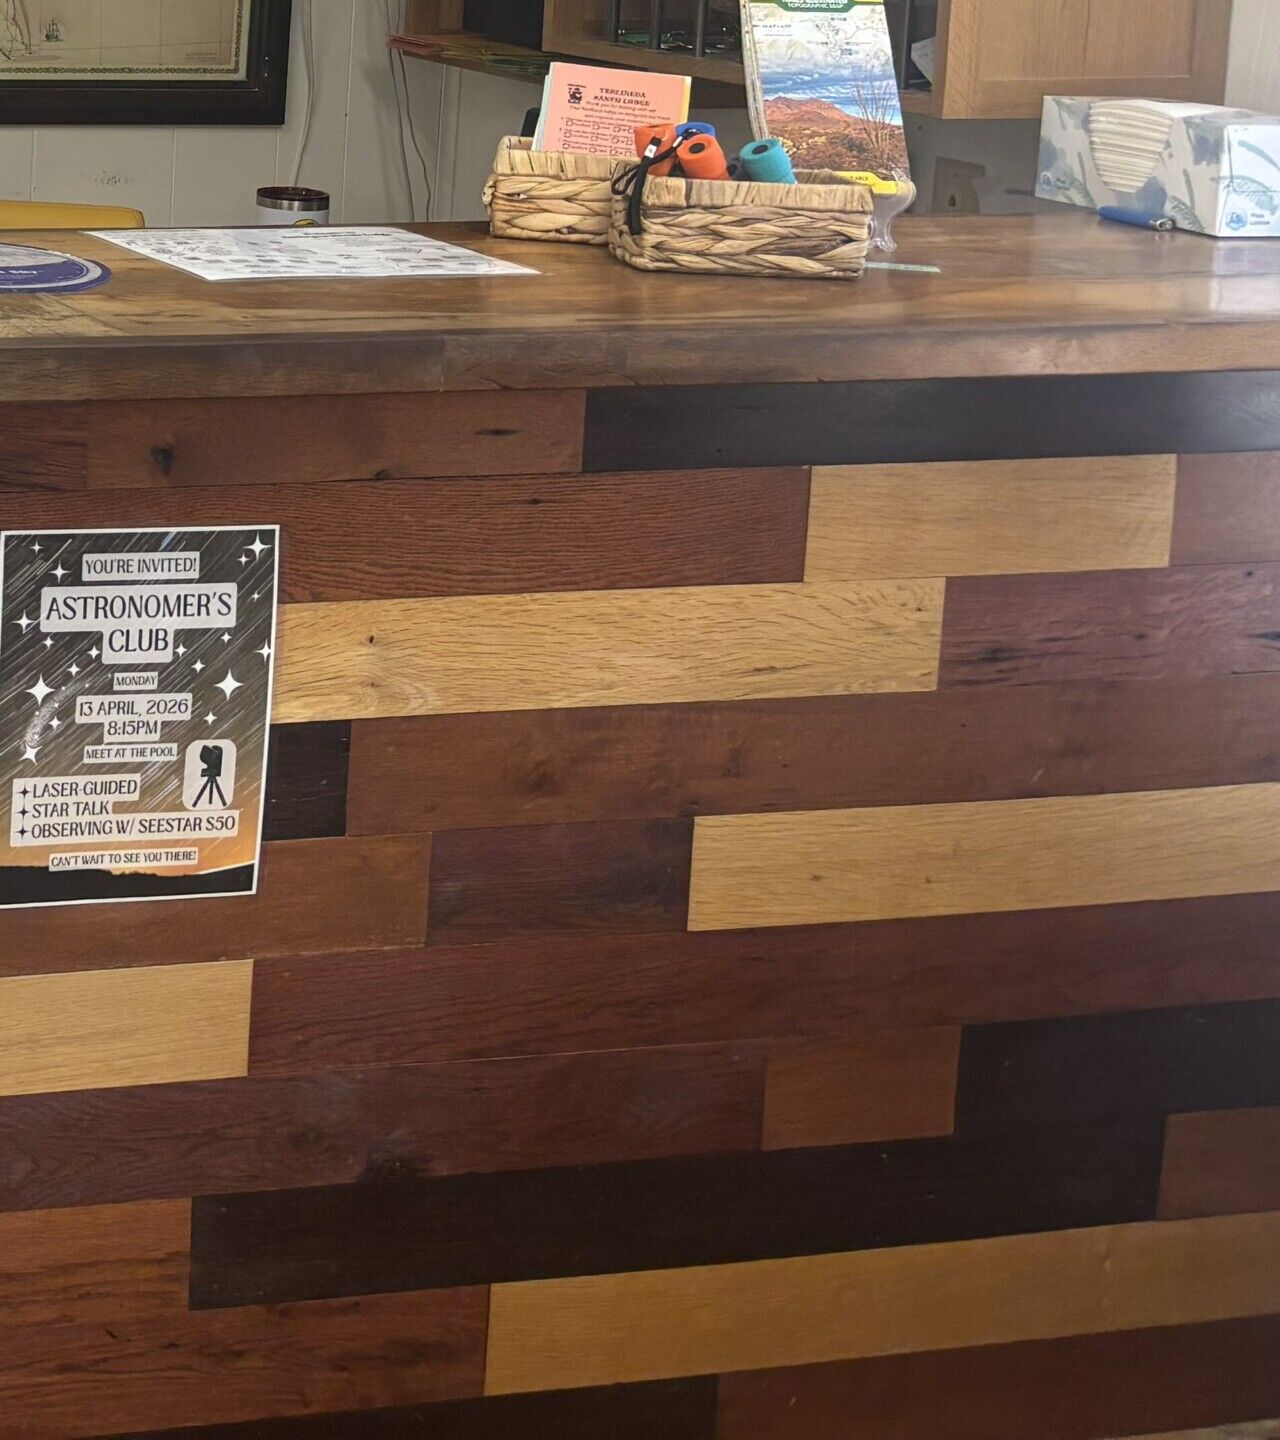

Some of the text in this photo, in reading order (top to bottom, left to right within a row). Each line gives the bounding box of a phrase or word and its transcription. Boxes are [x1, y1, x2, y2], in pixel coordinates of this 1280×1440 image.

[86, 557, 197, 575] YOU'RE INVITED!
[46, 592, 232, 621] ASTRONOMER'S
[108, 629, 169, 653] CLUB
[115, 675, 157, 687] MONDAY
[79, 699, 189, 718] 13 APRIL, 2026
[107, 720, 158, 736] 8:15PM
[86, 745, 175, 759] MEET AT THE POOL
[32, 779, 138, 799] LASER-GUIDED
[32, 801, 110, 819] STAR TALK
[31, 816, 236, 839] OBSERVING W/ SEESTAR S50
